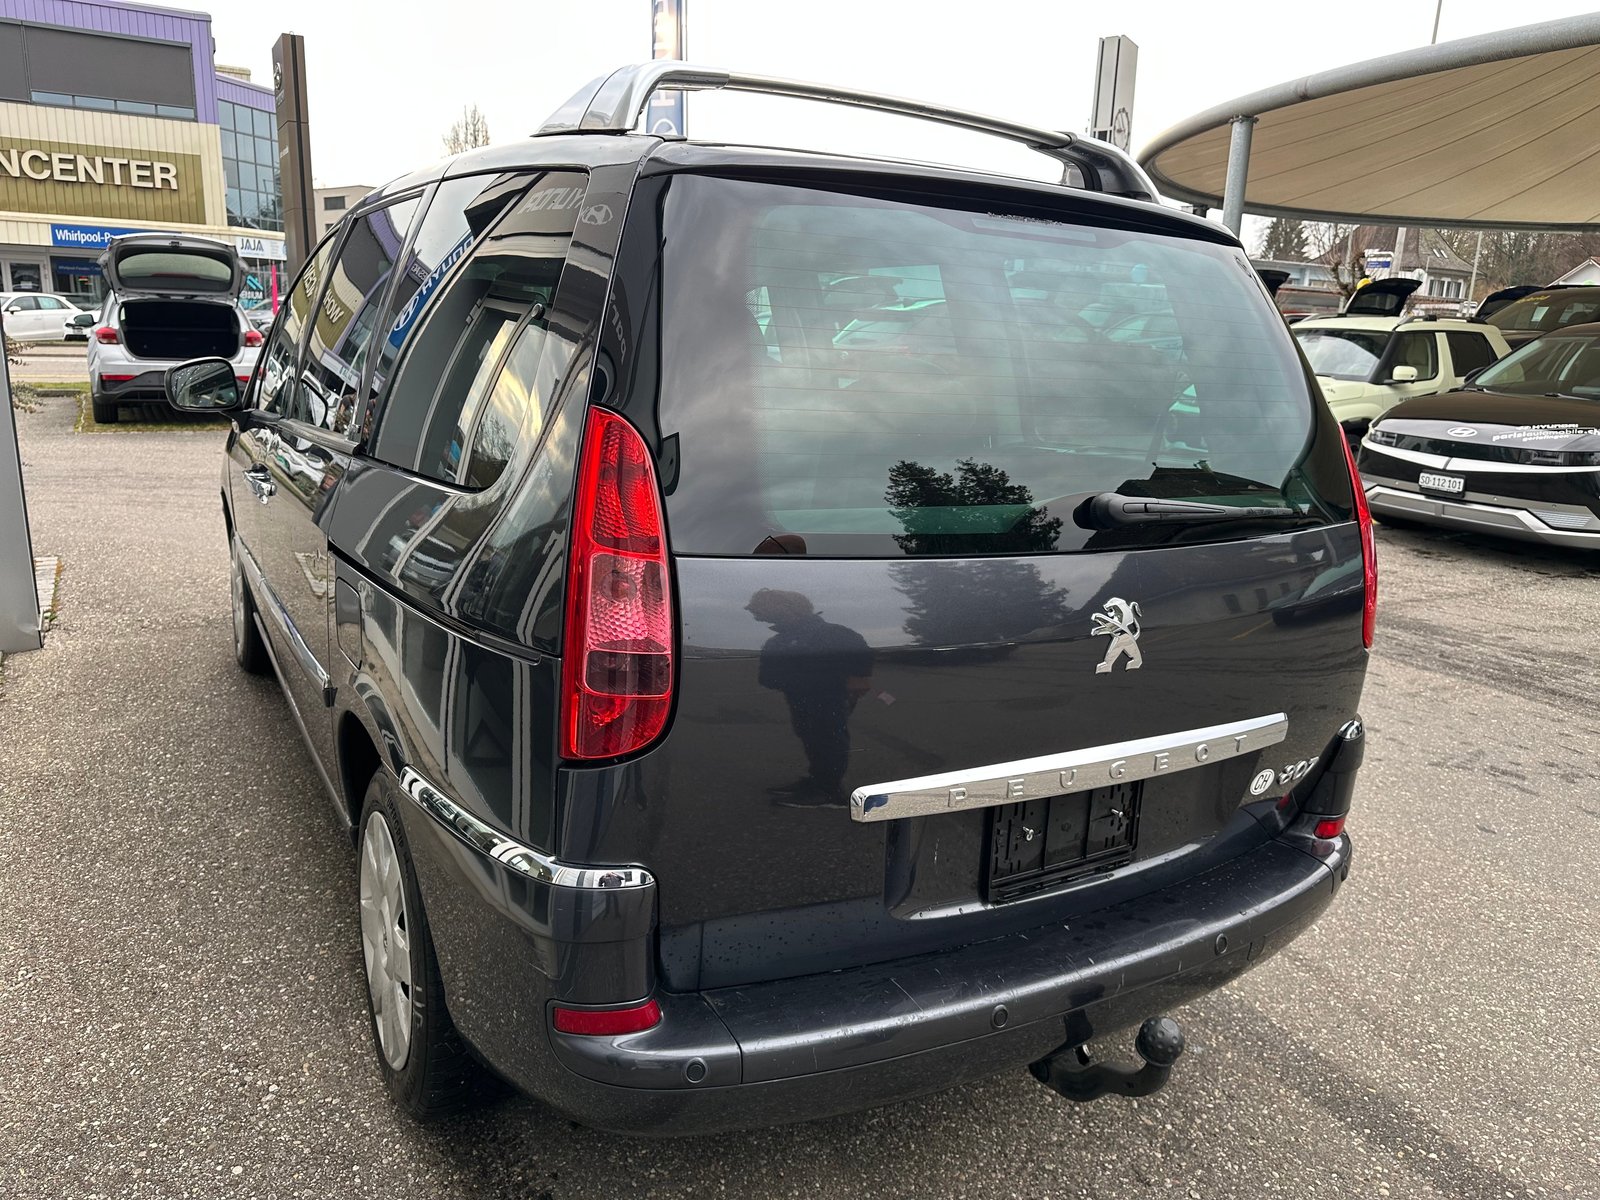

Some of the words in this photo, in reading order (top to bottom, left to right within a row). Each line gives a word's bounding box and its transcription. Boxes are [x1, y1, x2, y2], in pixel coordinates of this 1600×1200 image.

[0, 148, 178, 190] NCENTER
[55, 229, 115, 244] Whirlpool-P
[240, 237, 264, 252] JAJA
[948, 734, 1248, 808] PEUGEOT
[1278, 756, 1320, 785] 807
